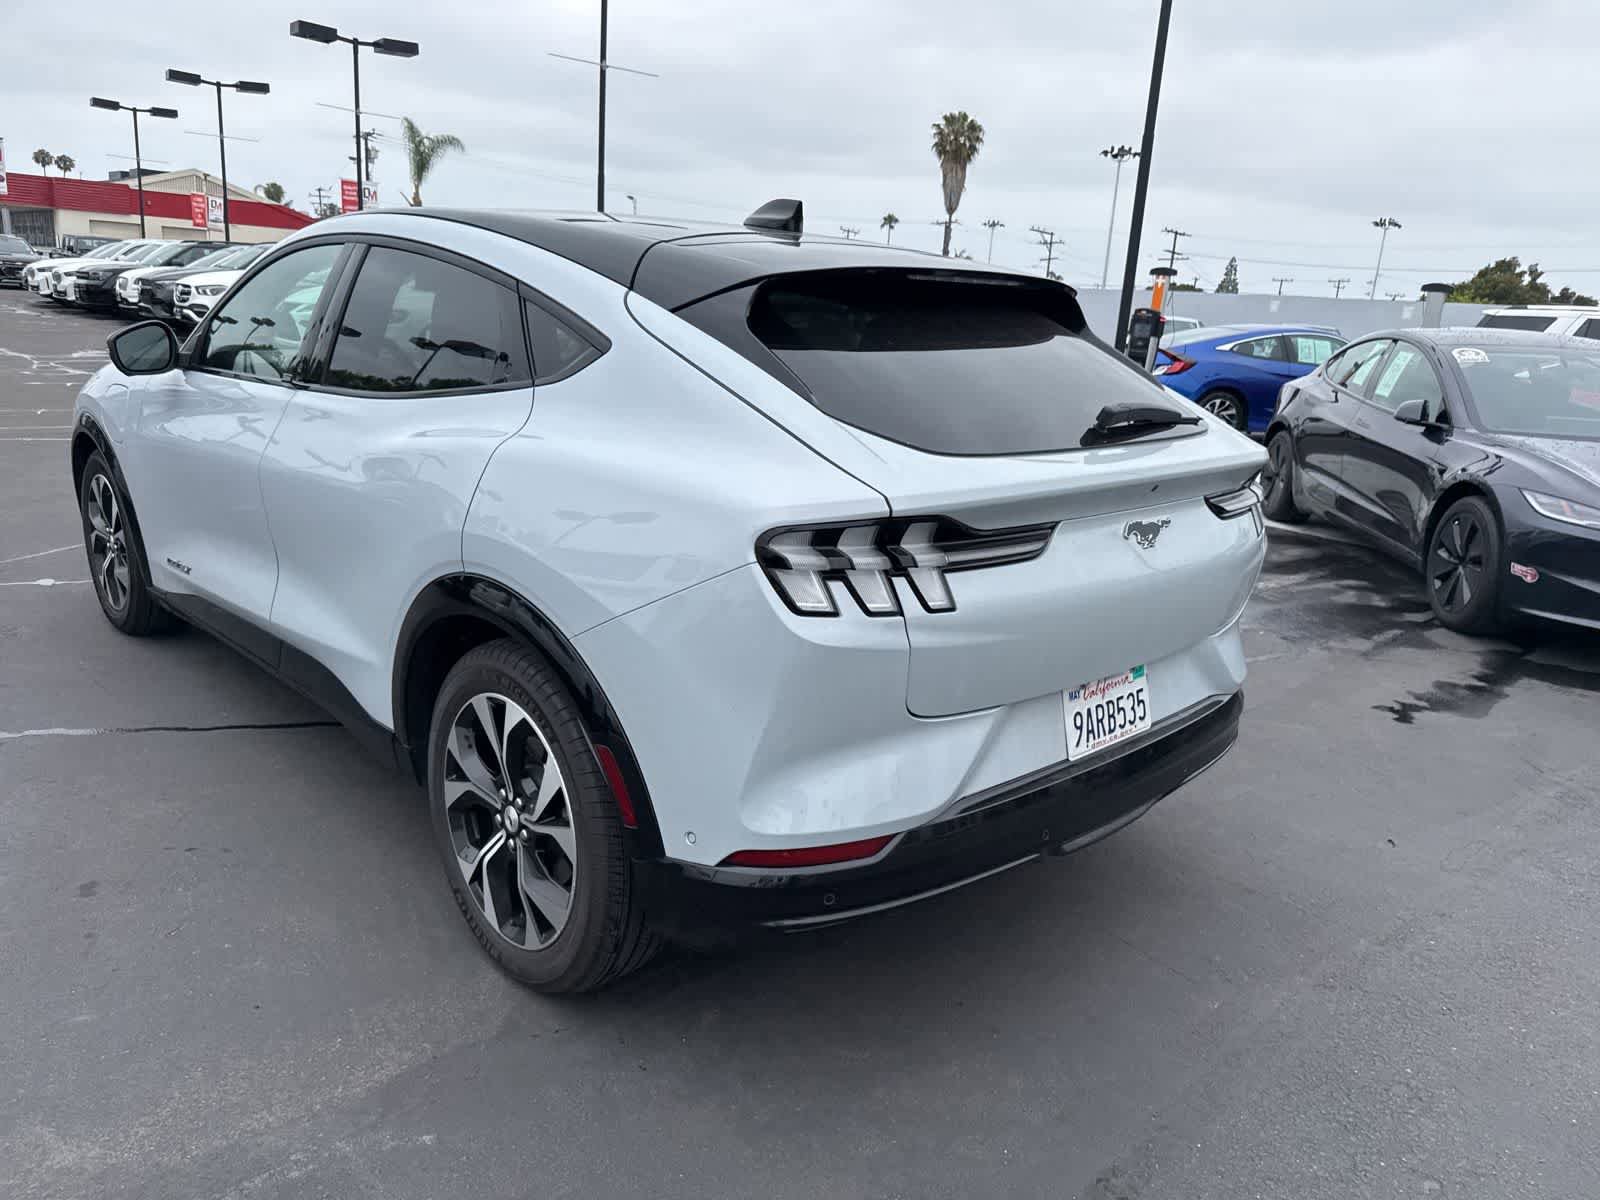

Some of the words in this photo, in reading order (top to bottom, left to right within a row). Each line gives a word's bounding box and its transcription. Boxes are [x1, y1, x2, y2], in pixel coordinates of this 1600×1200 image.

[1068, 689, 1081, 701] MAY
[1082, 676, 1134, 701] California
[1073, 687, 1147, 748] 9ARB535
